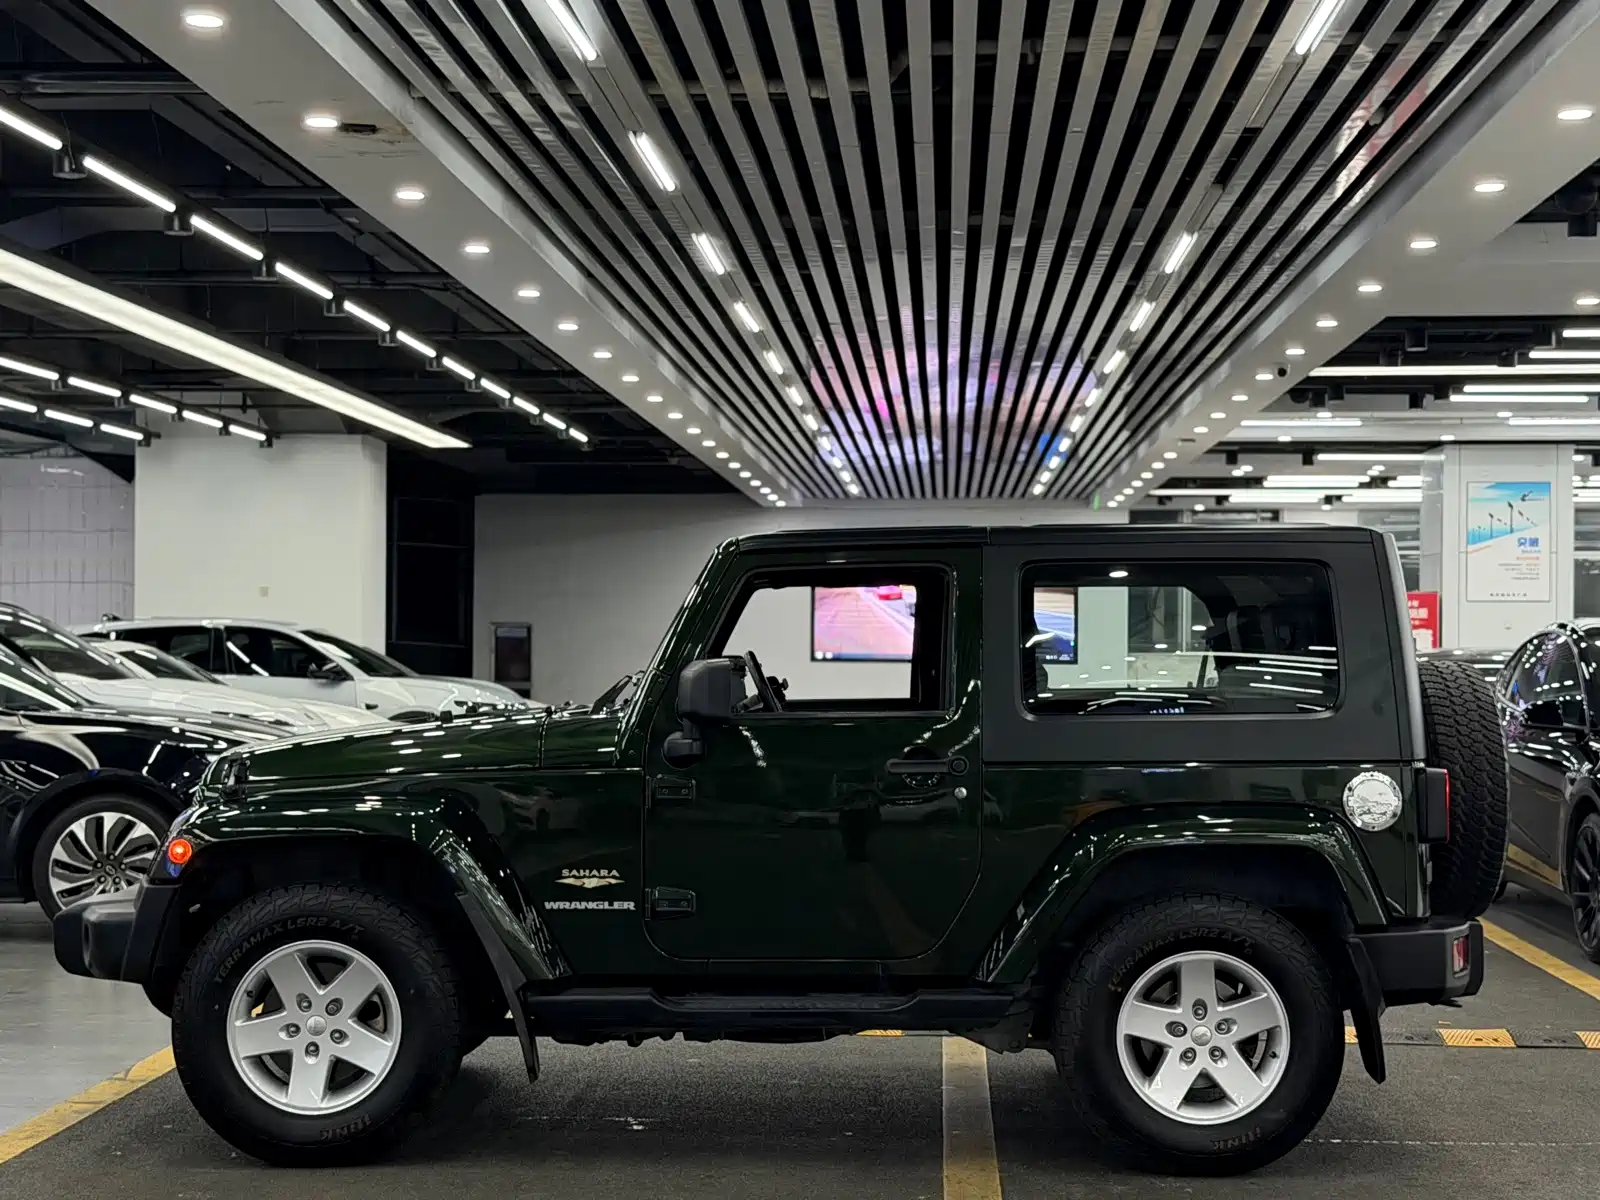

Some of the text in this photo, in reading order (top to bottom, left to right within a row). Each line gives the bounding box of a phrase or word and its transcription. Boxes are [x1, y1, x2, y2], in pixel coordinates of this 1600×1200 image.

[561, 868, 620, 877] SAHARA
[544, 901, 636, 910] WRANGLER
[214, 923, 284, 983] TERRAMAX
